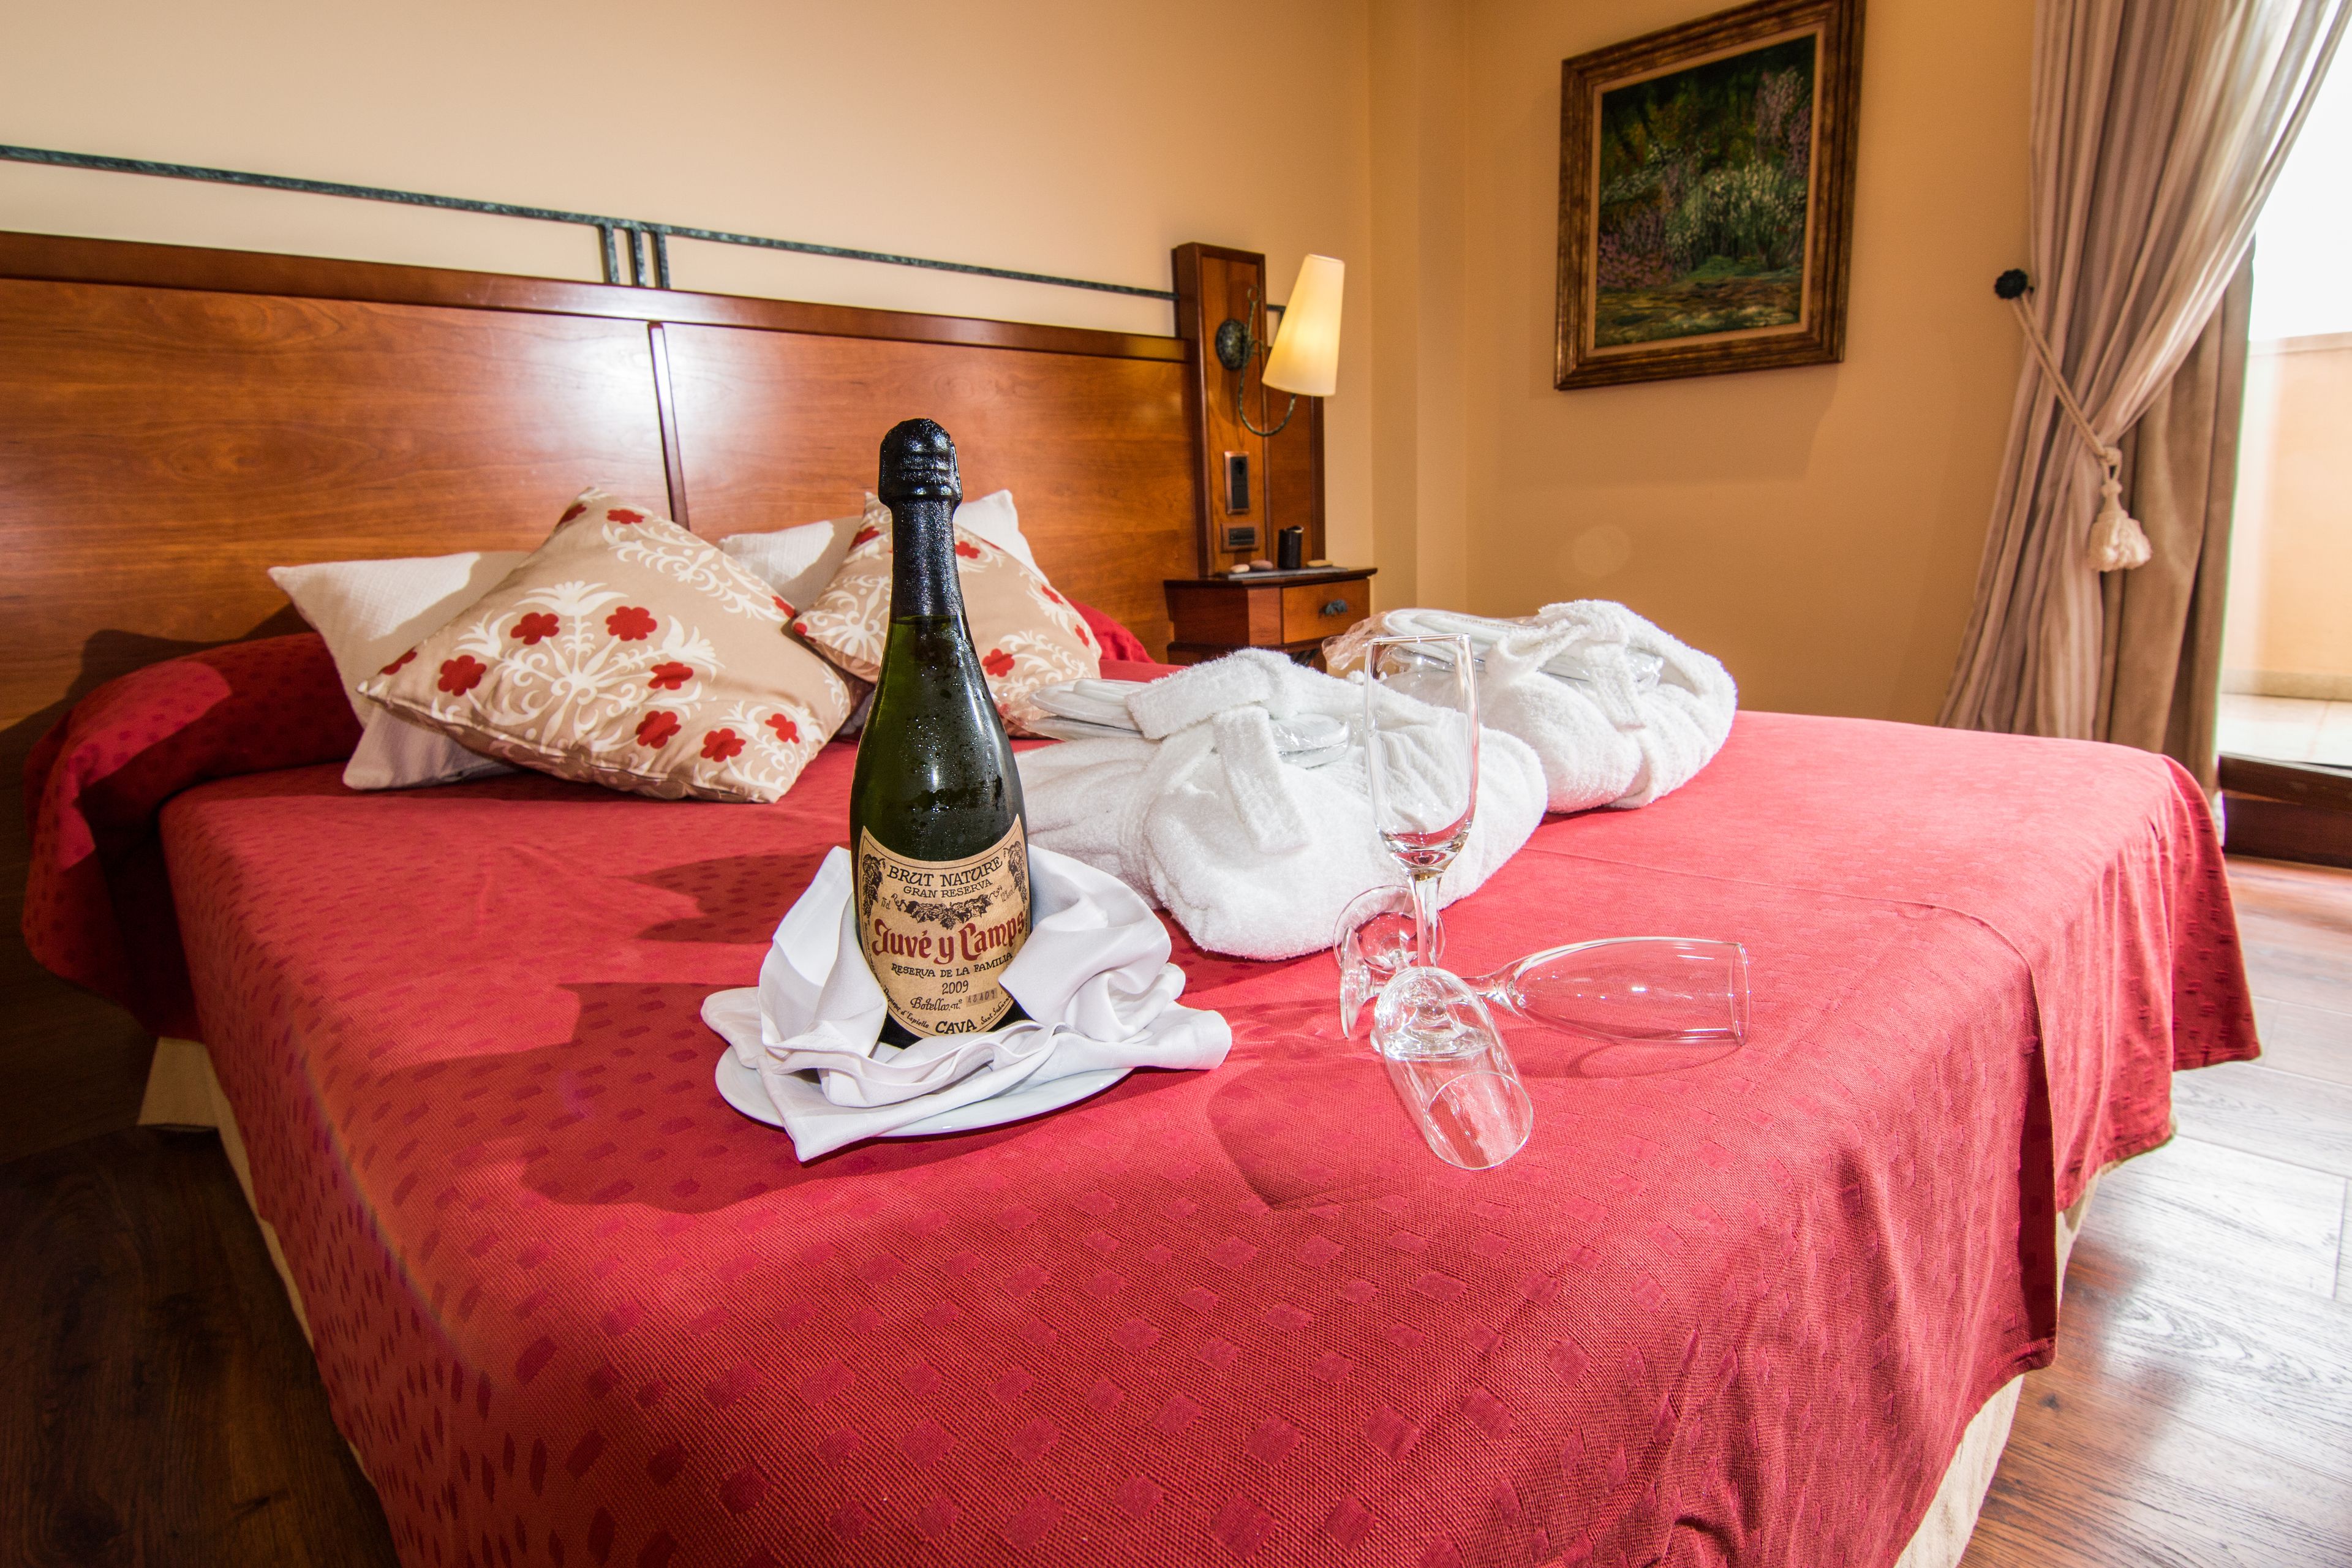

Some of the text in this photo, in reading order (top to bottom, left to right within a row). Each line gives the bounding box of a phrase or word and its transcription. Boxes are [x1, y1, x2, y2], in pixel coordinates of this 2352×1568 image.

[887, 856, 1003, 887] BRUT NATURE
[903, 878, 993, 898] GRAN RESERVA
[872, 918, 932, 959] Juvé
[933, 936, 954, 965] y
[958, 911, 1025, 961] Camps
[891, 952, 1013, 979] RESERVA DE LA FAMILIA
[941, 980, 969, 995] 2009
[935, 1019, 977, 1035] CAVA
[981, 1013, 993, 1025] Sant
